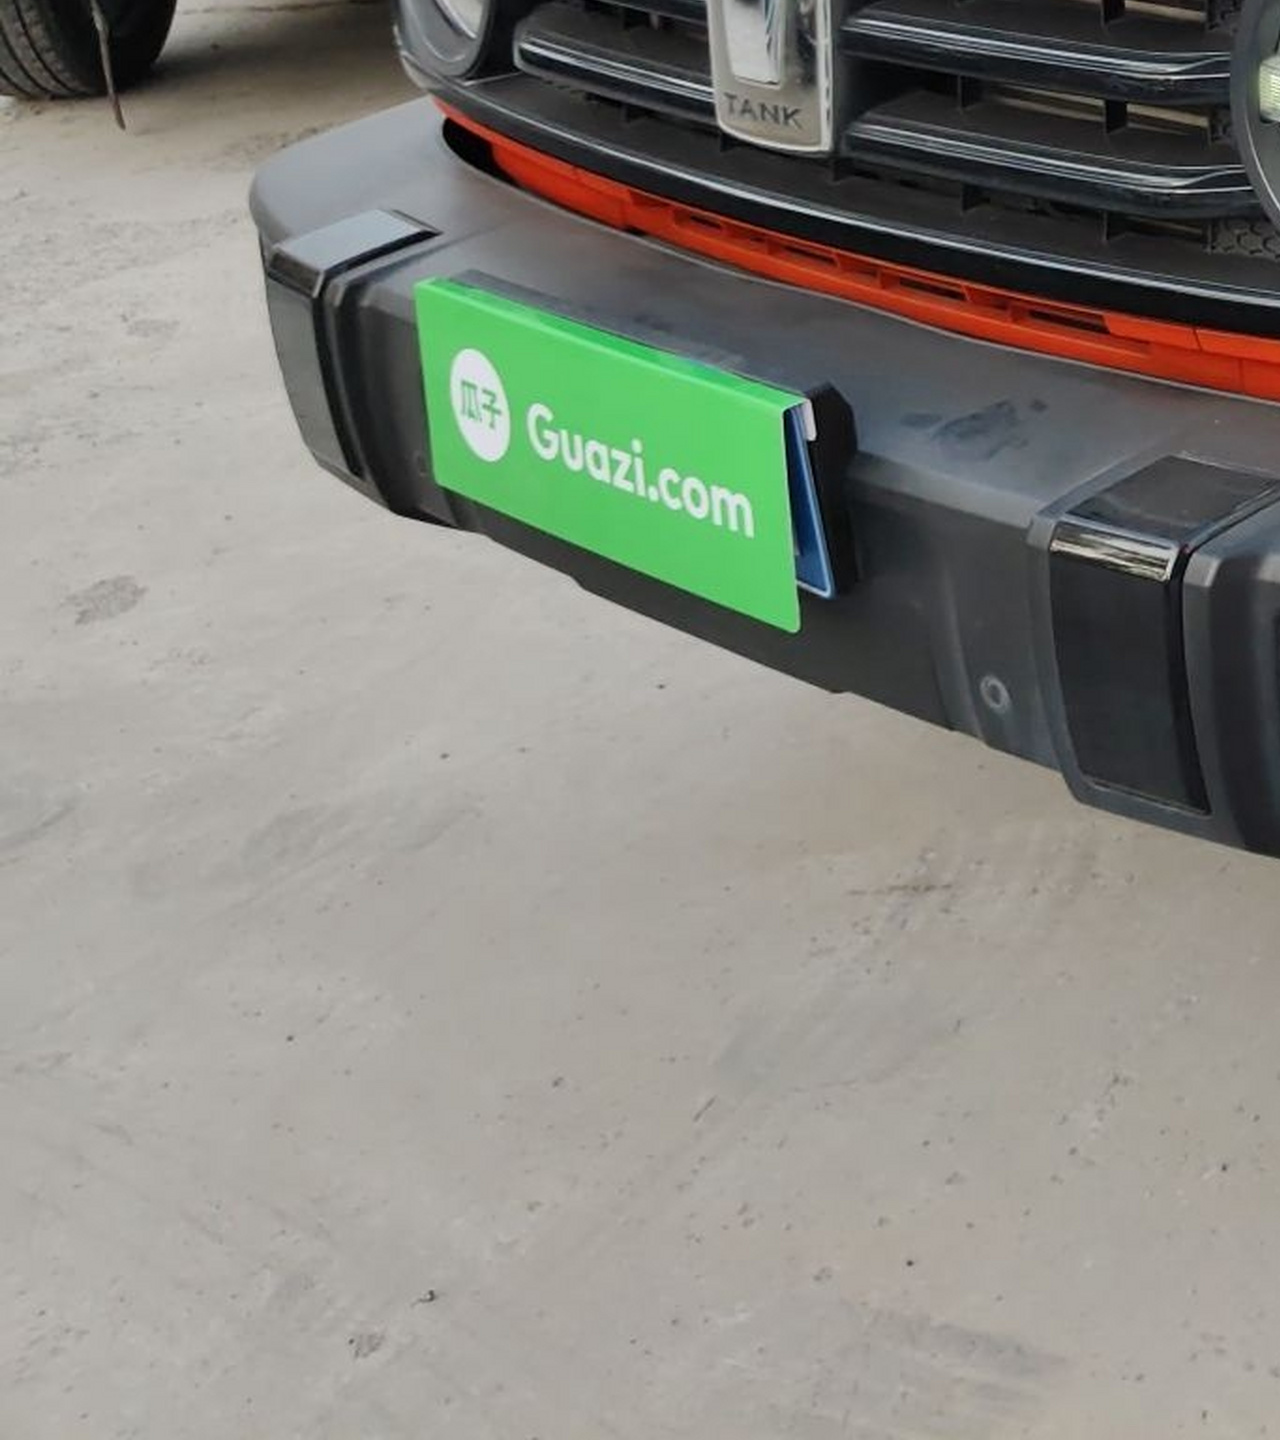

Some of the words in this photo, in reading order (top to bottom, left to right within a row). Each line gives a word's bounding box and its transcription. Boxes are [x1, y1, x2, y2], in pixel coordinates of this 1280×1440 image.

[723, 91, 803, 130] TANK
[460, 379, 502, 429] 瓜子
[526, 403, 755, 538] Guazi.com
